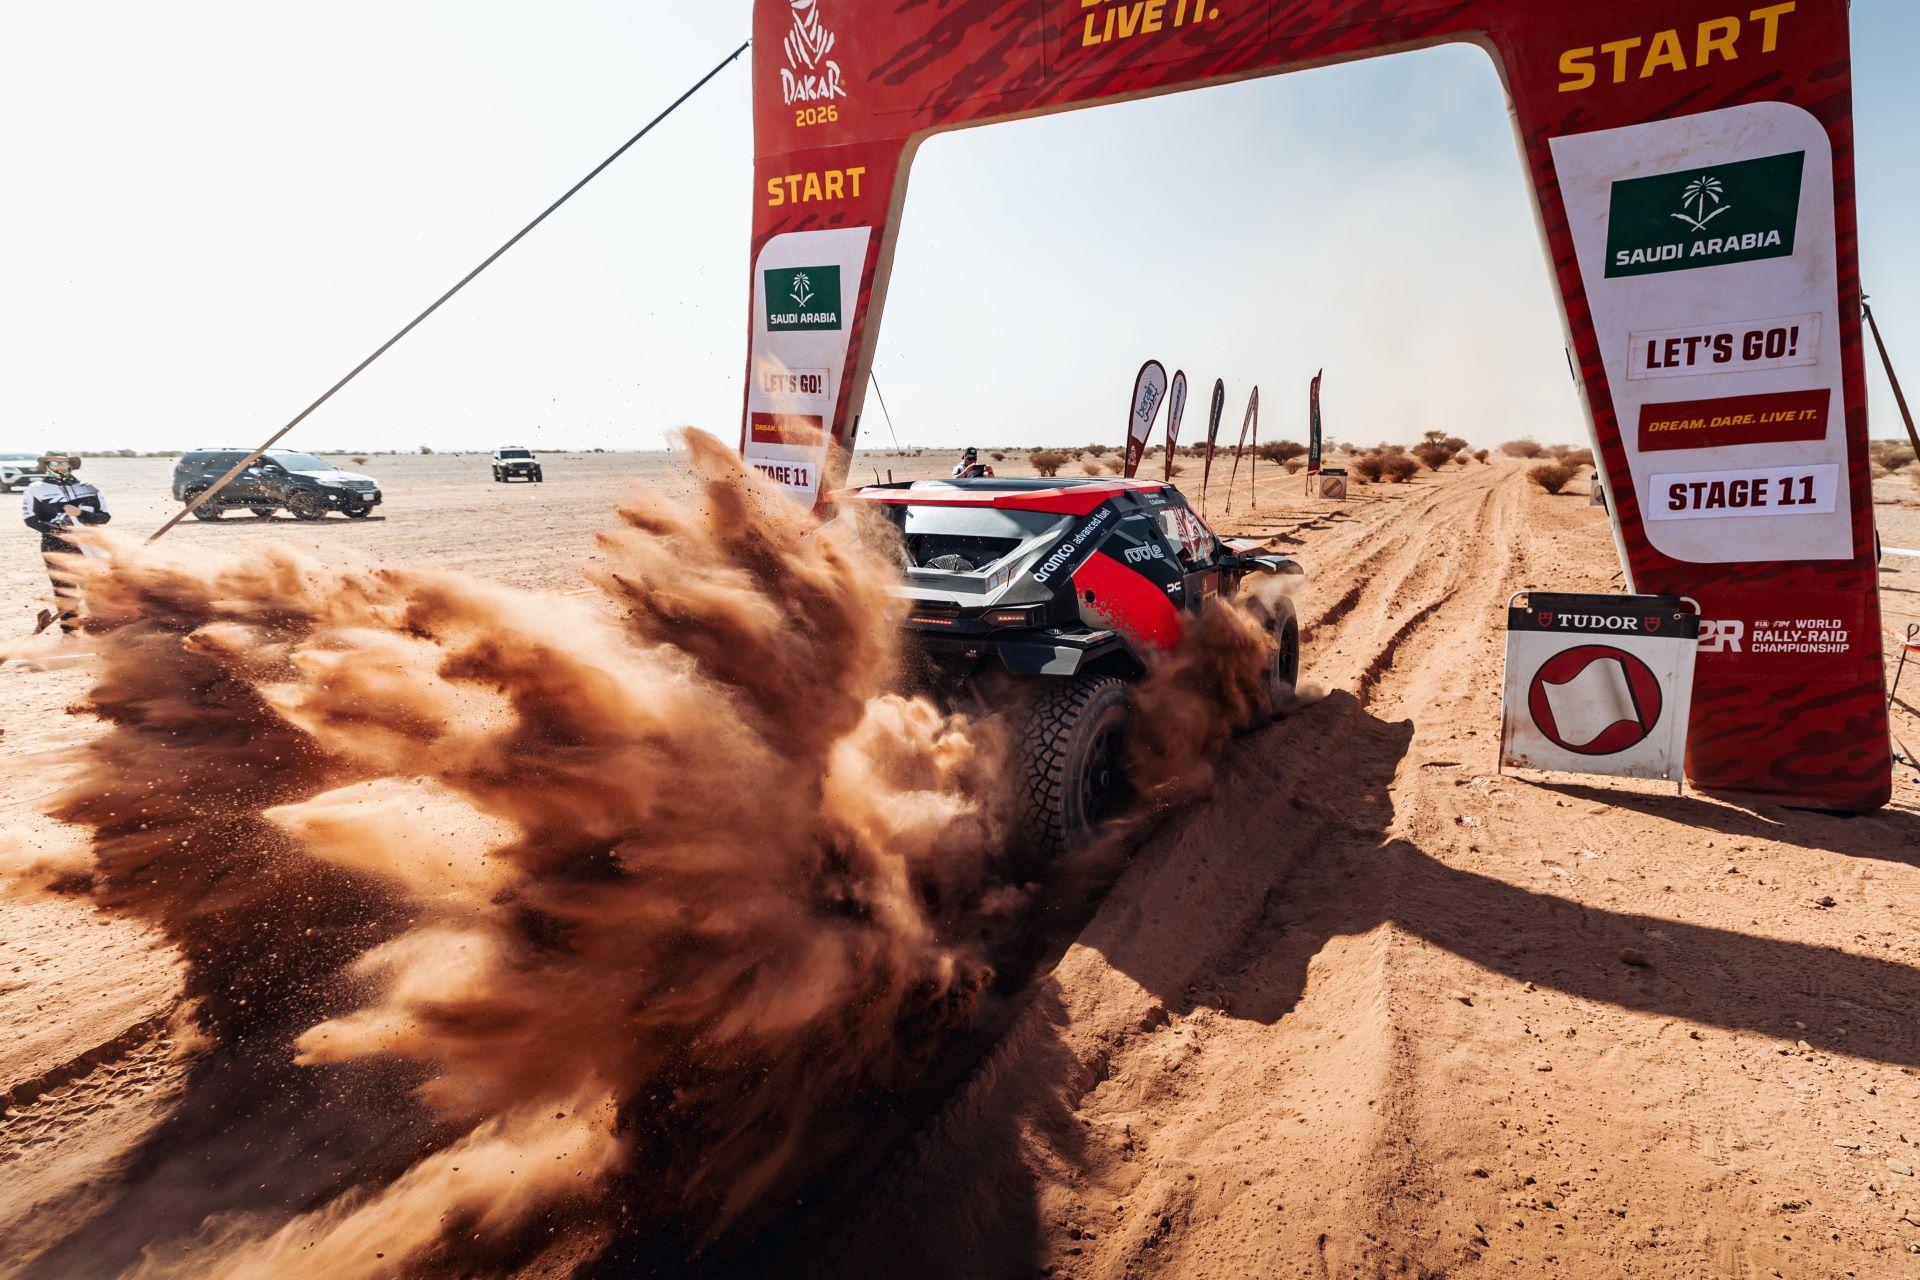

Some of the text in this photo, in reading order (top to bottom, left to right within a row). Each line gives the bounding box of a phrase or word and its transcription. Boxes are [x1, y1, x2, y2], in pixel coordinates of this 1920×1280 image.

[1081, 0, 1167, 47] LIVE
[1558, 1, 1796, 93] START
[780, 60, 847, 105] DAKAR
[796, 105, 838, 127] 2026
[767, 167, 865, 207] START
[1615, 229, 1782, 266] SAUDI ARABIA
[770, 312, 837, 325] SAUDI ARABIA
[1646, 326, 1799, 369] LET'S GO!
[800, 374, 822, 394] GO!
[1648, 408, 1818, 432] DREAM. DARE. LIVE IT.
[794, 468, 809, 487] 11
[1668, 475, 1817, 511] STAGE 11
[1033, 507, 1112, 583] aramco advanced fuel
[1558, 614, 1639, 630] TUDOR
[1754, 620, 1770, 629] FIA
[1796, 619, 1842, 629] WORLD
[1752, 630, 1848, 643] RALLY-RAID
[1752, 643, 1850, 653] CHAMPIONSHIP
